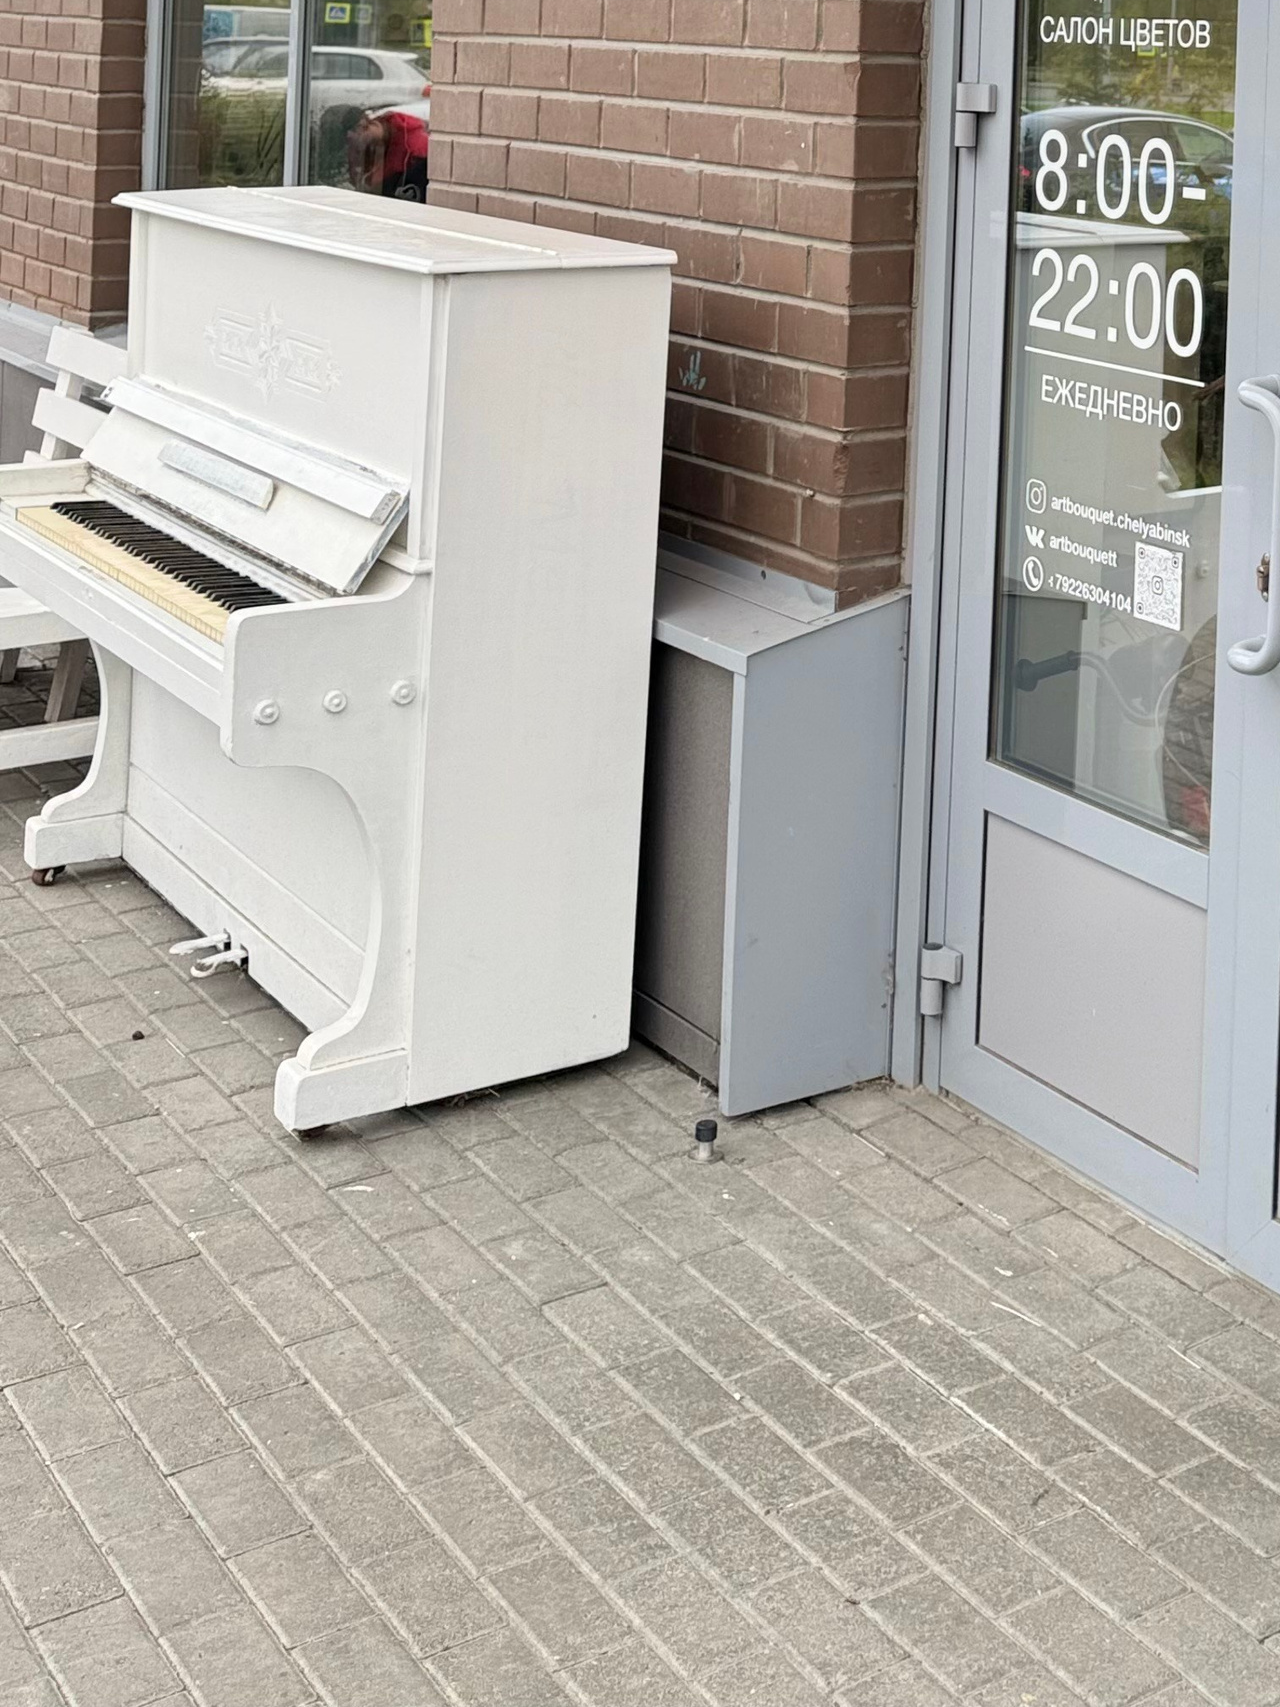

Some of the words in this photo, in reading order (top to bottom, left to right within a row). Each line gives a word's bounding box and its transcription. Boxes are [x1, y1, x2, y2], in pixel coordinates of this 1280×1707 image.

[1040, 16, 1113, 45] САЛОН
[1119, 18, 1211, 51] ЦВЕТОВ
[1035, 129, 1207, 225] 8:00-
[1028, 248, 1204, 358] 22:00
[1041, 374, 1182, 432] ЕЖЕДНЕВНО
[1051, 496, 1190, 548] artbouquet.chelyabinsk
[1049, 533, 1118, 567] artbouquett
[1048, 574, 1132, 614] +79226304104
